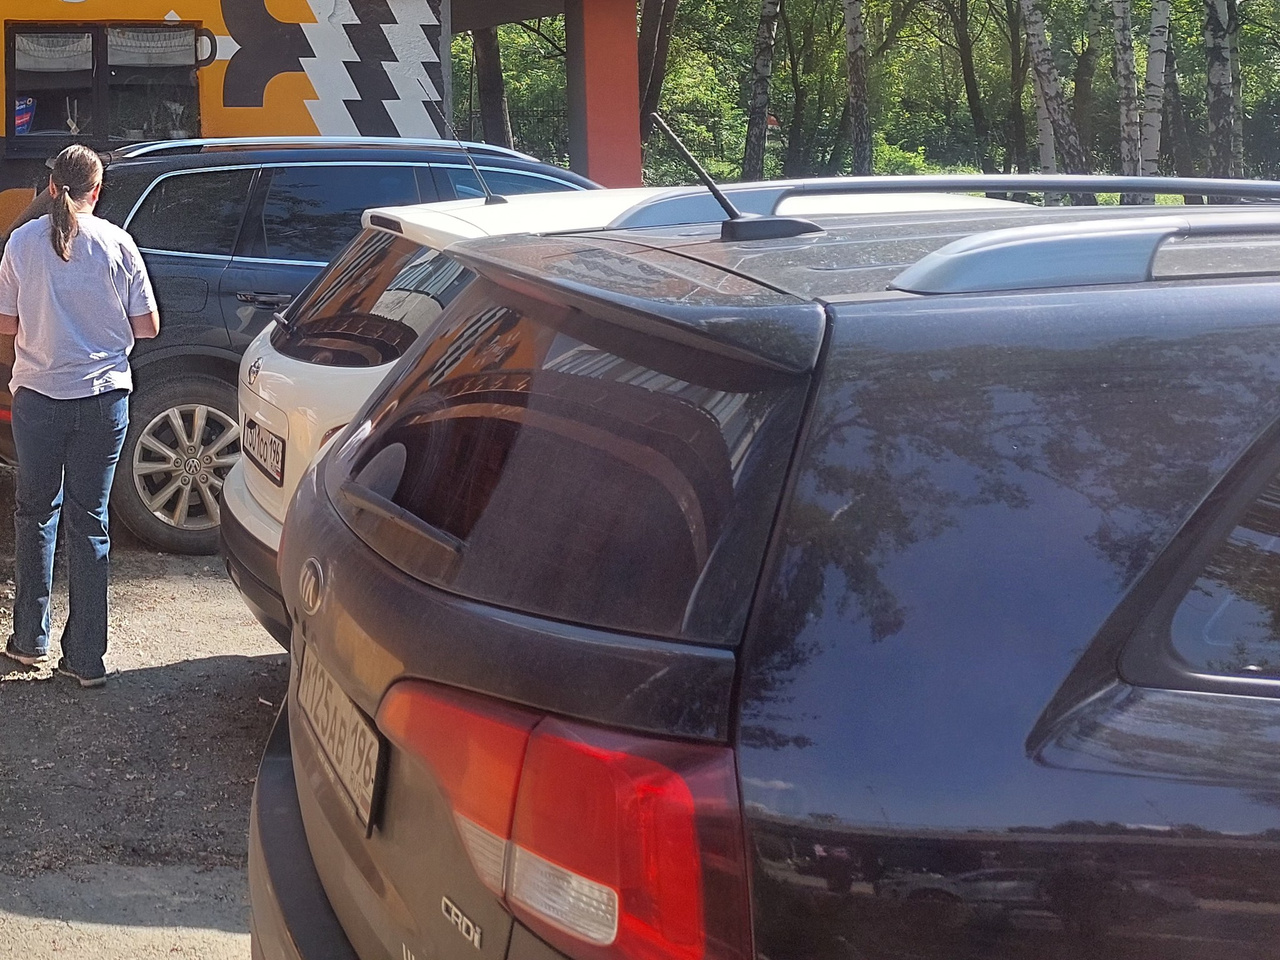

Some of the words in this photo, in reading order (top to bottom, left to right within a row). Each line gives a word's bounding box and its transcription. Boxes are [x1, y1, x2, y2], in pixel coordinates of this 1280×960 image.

[269, 437, 281, 465] 196
[351, 721, 374, 788] 196
[442, 896, 481, 950] CRDi
